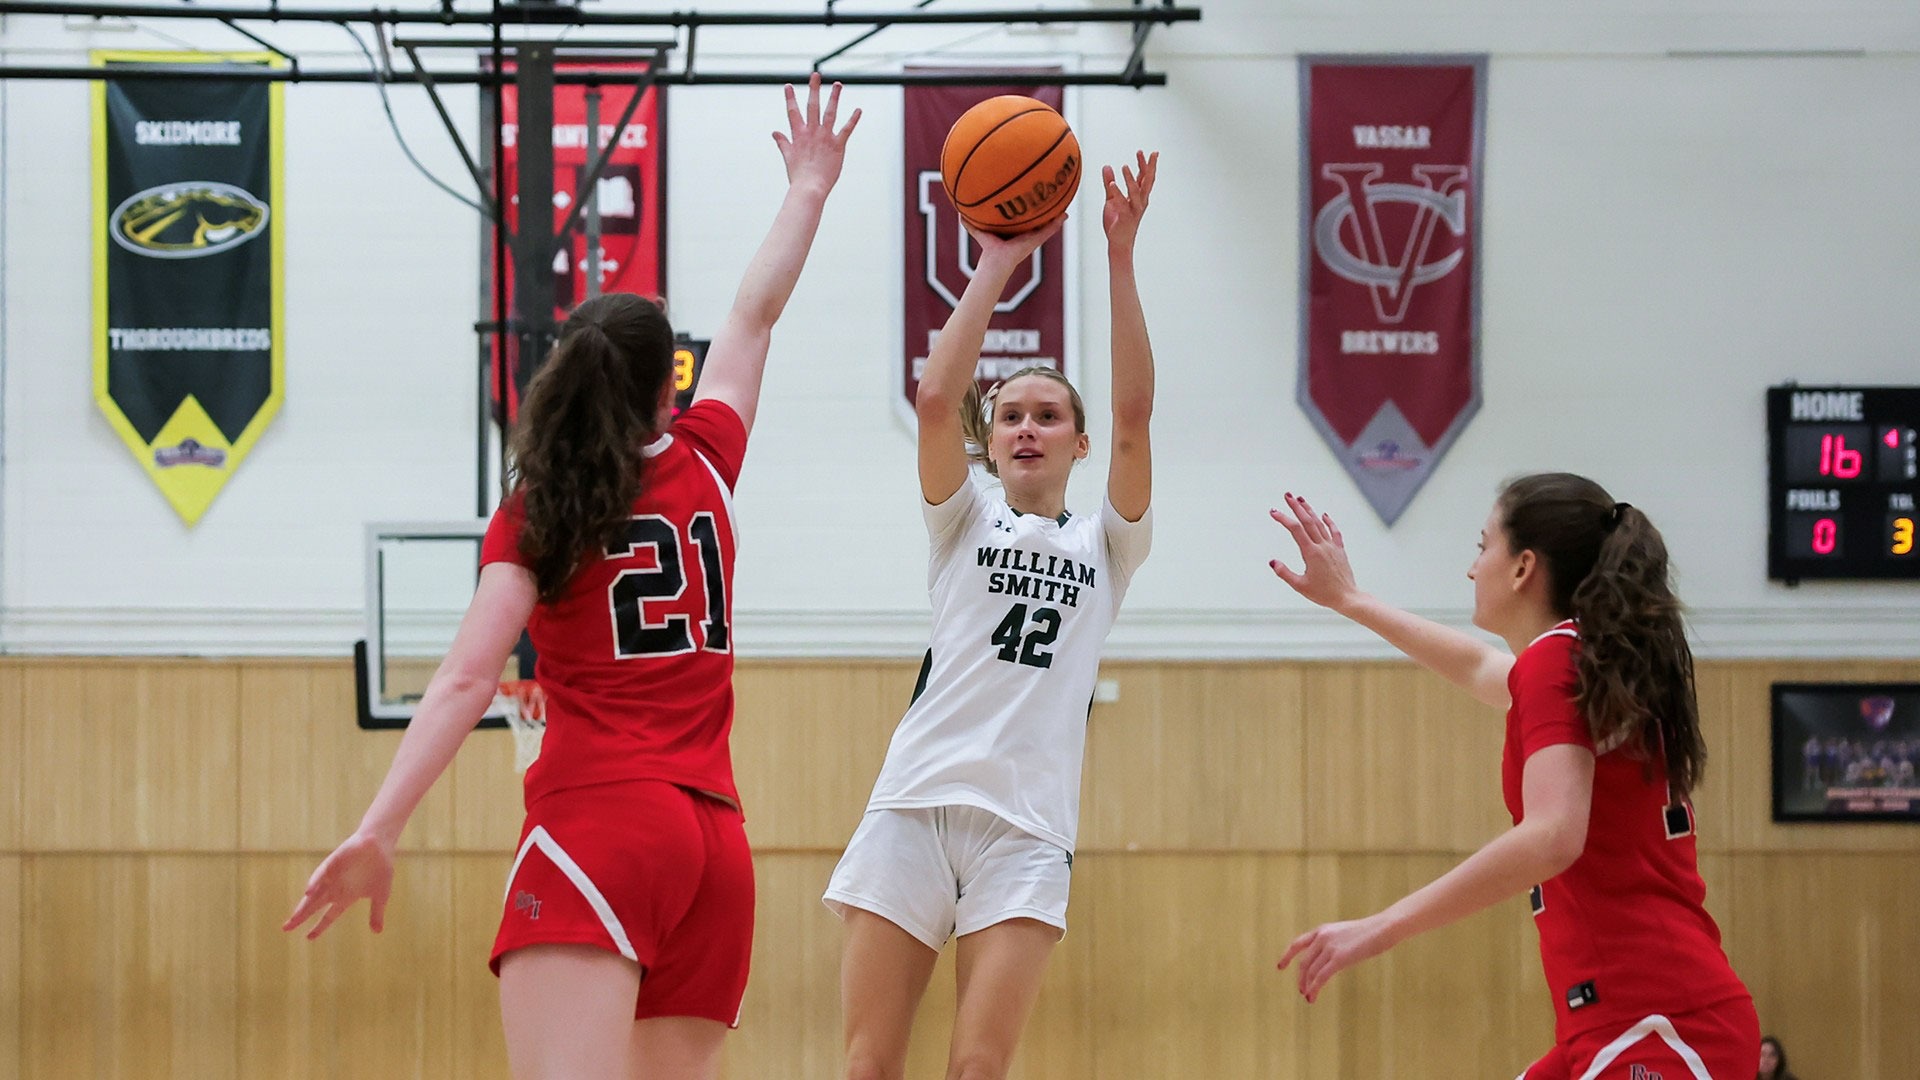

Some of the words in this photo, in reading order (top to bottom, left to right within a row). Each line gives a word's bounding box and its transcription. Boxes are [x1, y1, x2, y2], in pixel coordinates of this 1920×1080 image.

[135, 120, 241, 145] SKIDMORE
[1353, 125, 1431, 148] VASSAR
[995, 154, 1077, 220] Wilson
[109, 328, 271, 350] THOROUGHBREDS
[1341, 331, 1439, 354] BREWERS
[1791, 391, 1863, 420] HOME
[1820, 433, 1862, 478] 16
[1786, 489, 1840, 511] FOULS
[1812, 517, 1837, 554] 0
[1891, 517, 1914, 554] 3
[977, 547, 1096, 588] WILLIAM
[602, 511, 731, 661] 21
[988, 573, 1081, 608] SMITH
[991, 603, 1062, 669] 42
